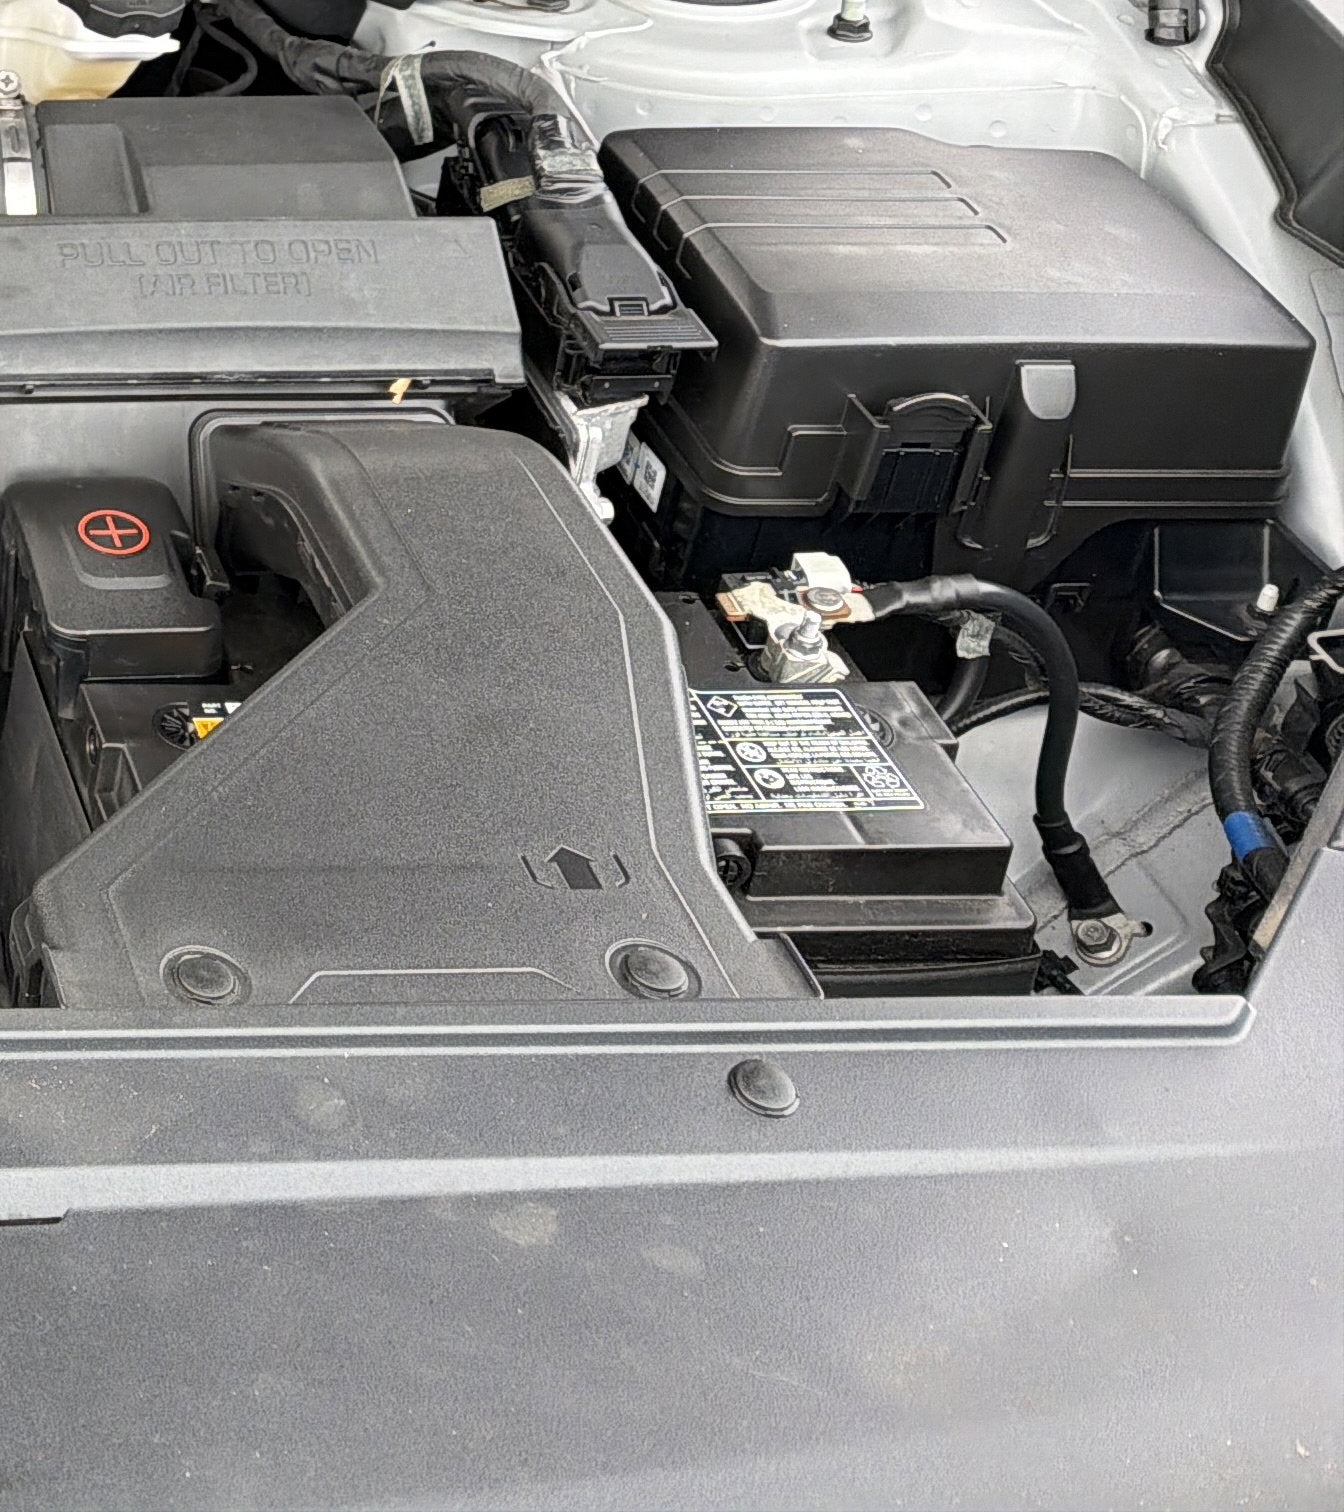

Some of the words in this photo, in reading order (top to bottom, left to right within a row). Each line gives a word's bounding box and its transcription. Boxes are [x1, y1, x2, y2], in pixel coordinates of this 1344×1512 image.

[58, 241, 145, 269] PULL
[155, 239, 222, 266] OUT
[230, 240, 278, 266] TO
[288, 238, 379, 265] OPEN
